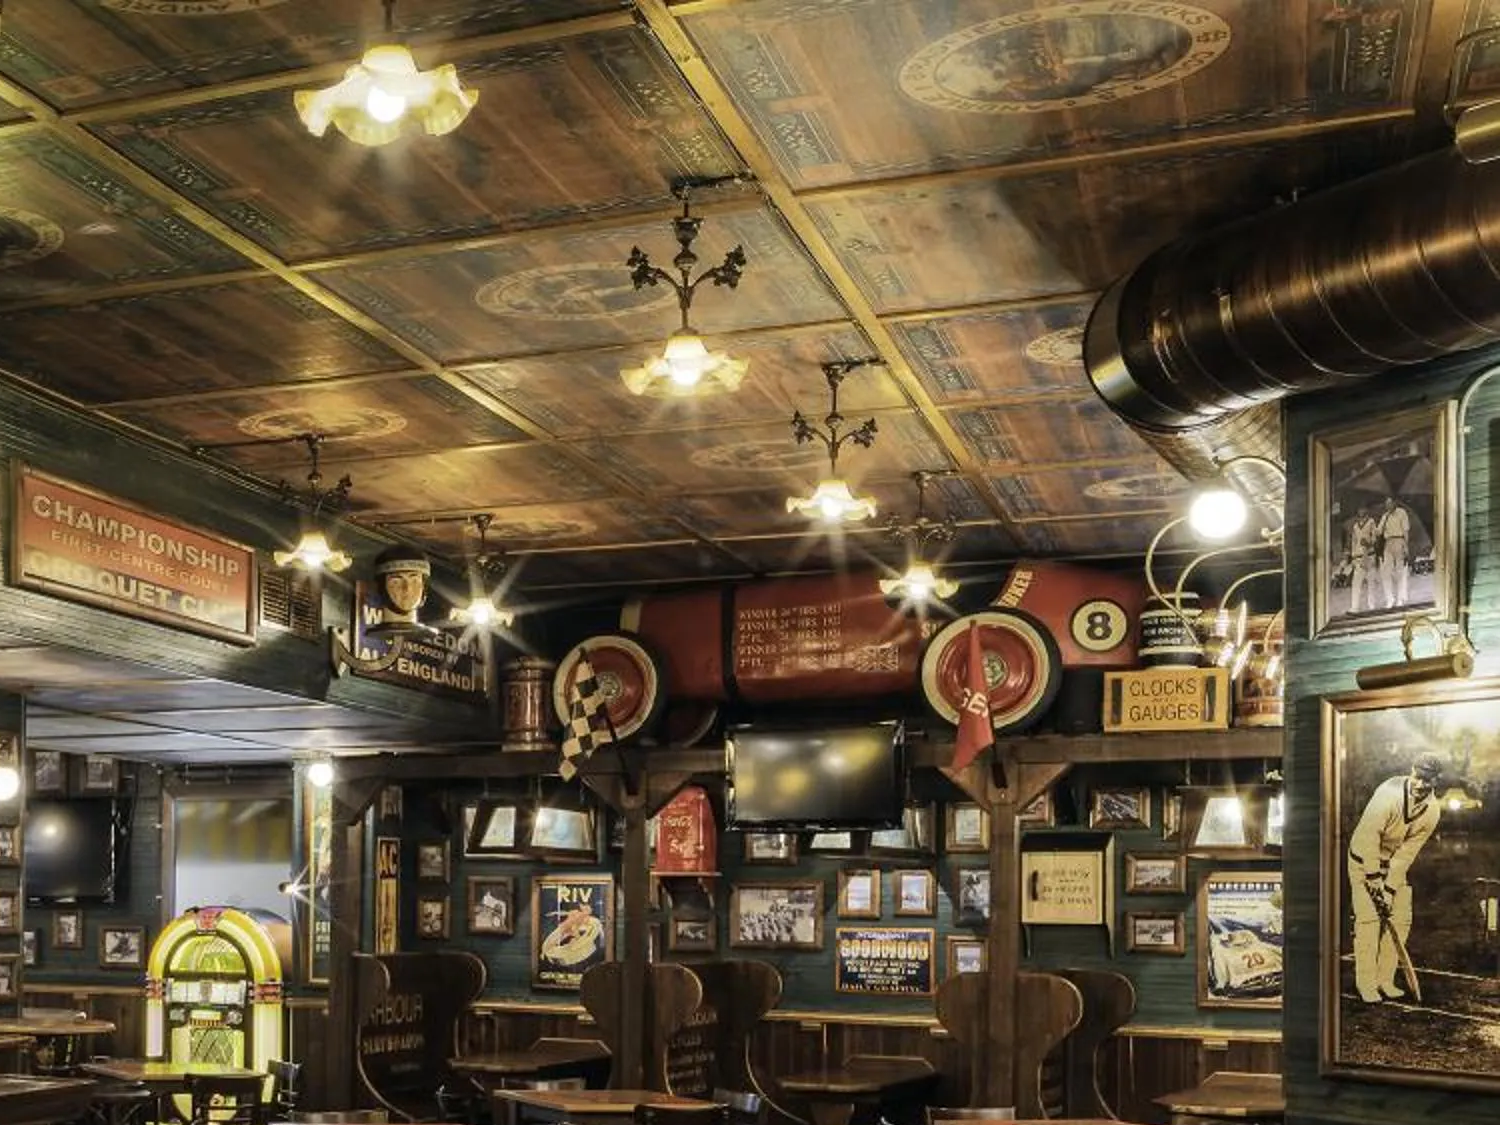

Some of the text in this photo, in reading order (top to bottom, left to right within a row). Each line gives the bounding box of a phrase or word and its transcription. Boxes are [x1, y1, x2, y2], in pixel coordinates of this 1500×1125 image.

[32, 495, 240, 577] CHAMPIONSHIP
[1086, 611, 1112, 640] 8
[397, 658, 472, 691] ENGLAND
[1129, 678, 1198, 697] CLOCKS
[1129, 703, 1199, 722] GAUGES
[841, 940, 929, 960] GOODWOOD
[1242, 952, 1265, 969] 20
